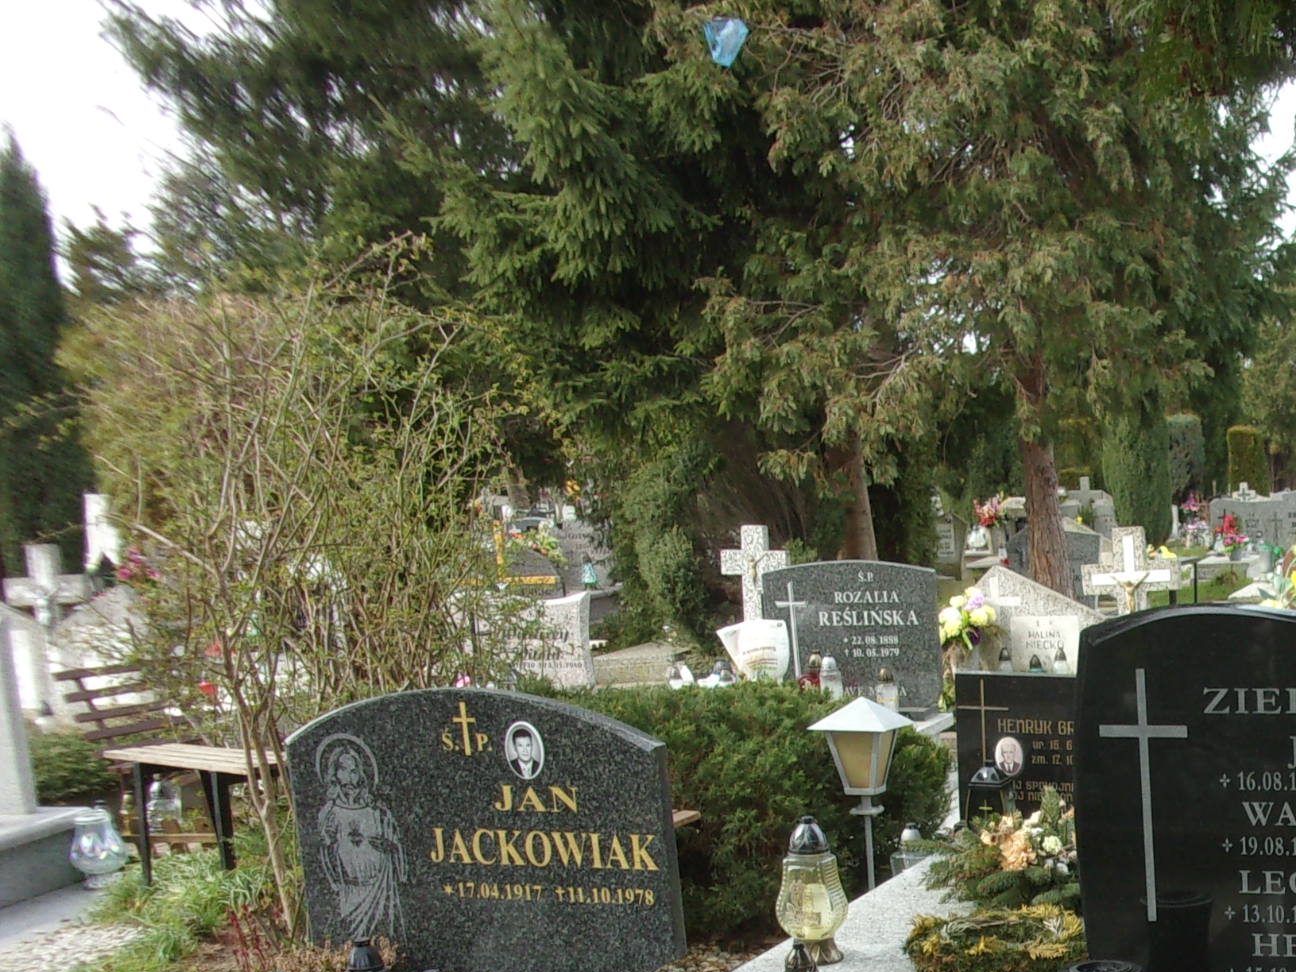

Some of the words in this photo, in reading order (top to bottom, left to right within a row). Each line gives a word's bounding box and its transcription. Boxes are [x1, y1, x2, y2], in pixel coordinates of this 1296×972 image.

[818, 606, 919, 626] REŚLIŃSKA
[1028, 631, 1061, 639] HALINA
[997, 718, 1053, 735] HENRYK
[495, 784, 578, 813] JAN
[430, 827, 660, 872] JACKOWIAK
